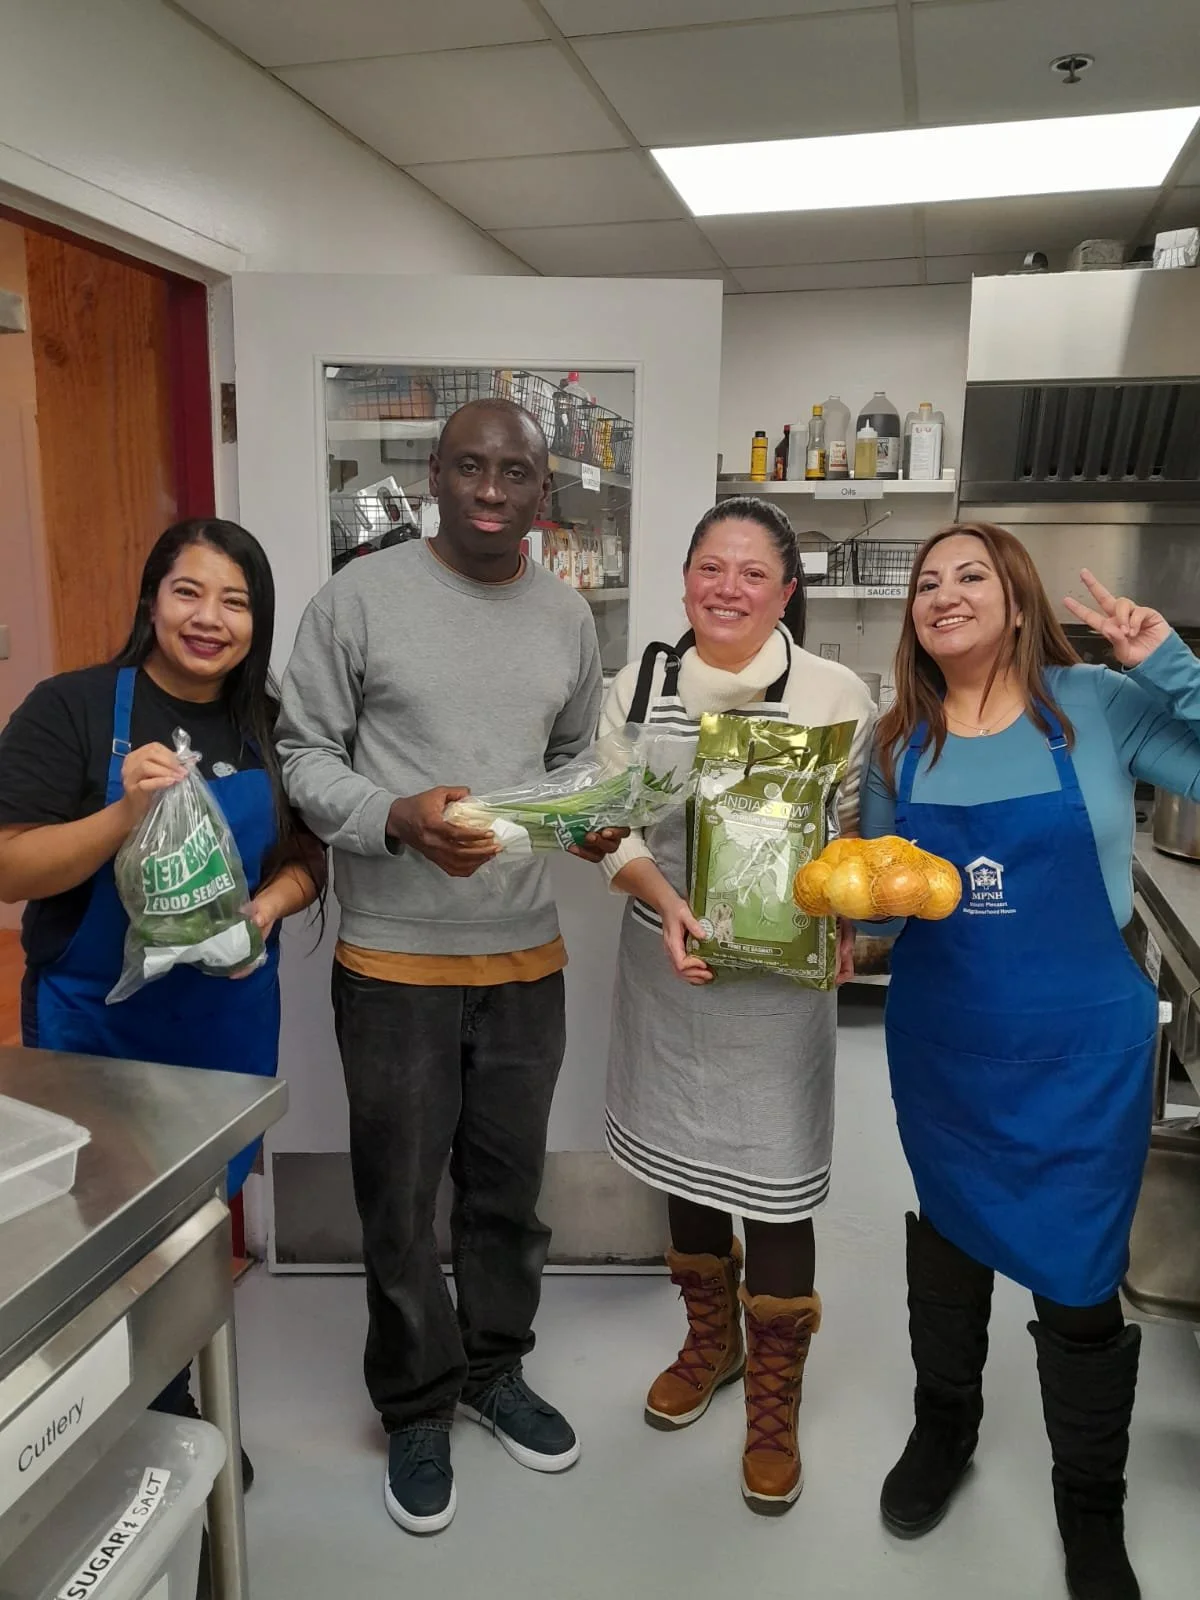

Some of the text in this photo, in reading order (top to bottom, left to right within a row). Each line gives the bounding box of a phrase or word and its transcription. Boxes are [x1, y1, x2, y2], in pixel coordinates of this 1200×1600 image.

[841, 487, 856, 497] Oils
[867, 588, 901, 596] SAUCES
[780, 802, 812, 819] OWN
[152, 893, 190, 910] FOOD
[972, 891, 1003, 900] MPNH
[18, 1396, 84, 1473] Cutlery
[67, 1532, 130, 1600] SUGAR
[132, 1471, 161, 1515] SALT
